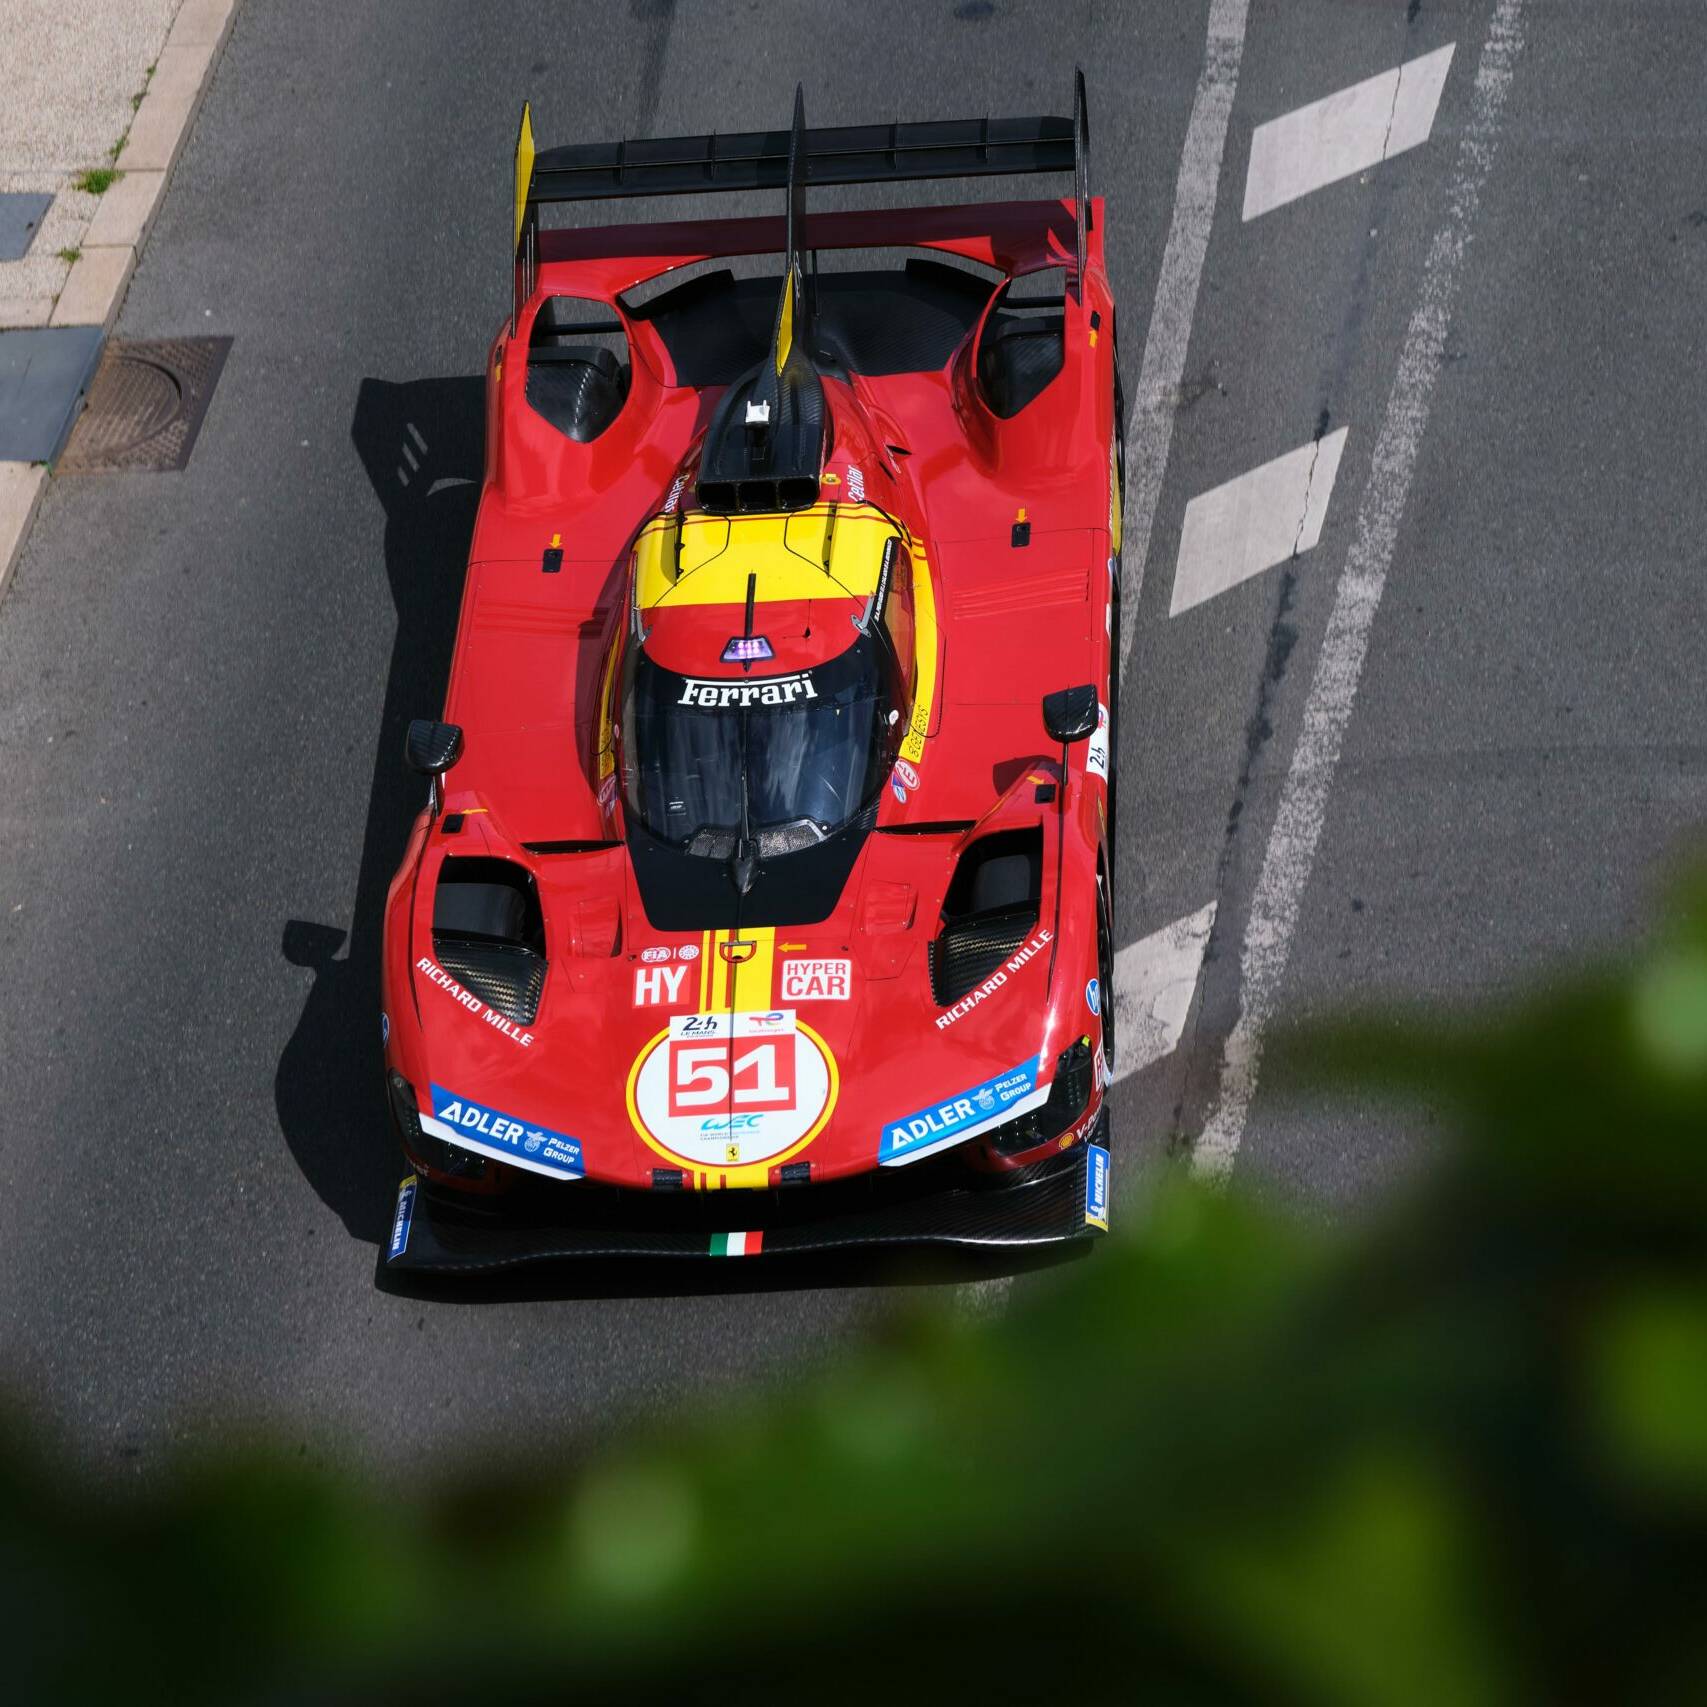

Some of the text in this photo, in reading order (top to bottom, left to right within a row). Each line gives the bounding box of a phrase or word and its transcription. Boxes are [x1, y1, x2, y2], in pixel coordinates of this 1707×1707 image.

[847, 464, 865, 502] Cetilar
[677, 673, 818, 707] Ferrari
[635, 965, 688, 1006] HY
[786, 975, 846, 997] CAR
[787, 962, 847, 976] HYPER
[935, 929, 1054, 1030] RICHARD MILLE
[416, 957, 535, 1047] RICHARD MILLE
[675, 1044, 790, 1107] 51
[438, 1100, 524, 1145] ADLER
[701, 1113, 764, 1131] WEC
[891, 1098, 976, 1151] ADLER
[1094, 1153, 1105, 1205] MICHELIN
[391, 1200, 408, 1251] MICHELIN
